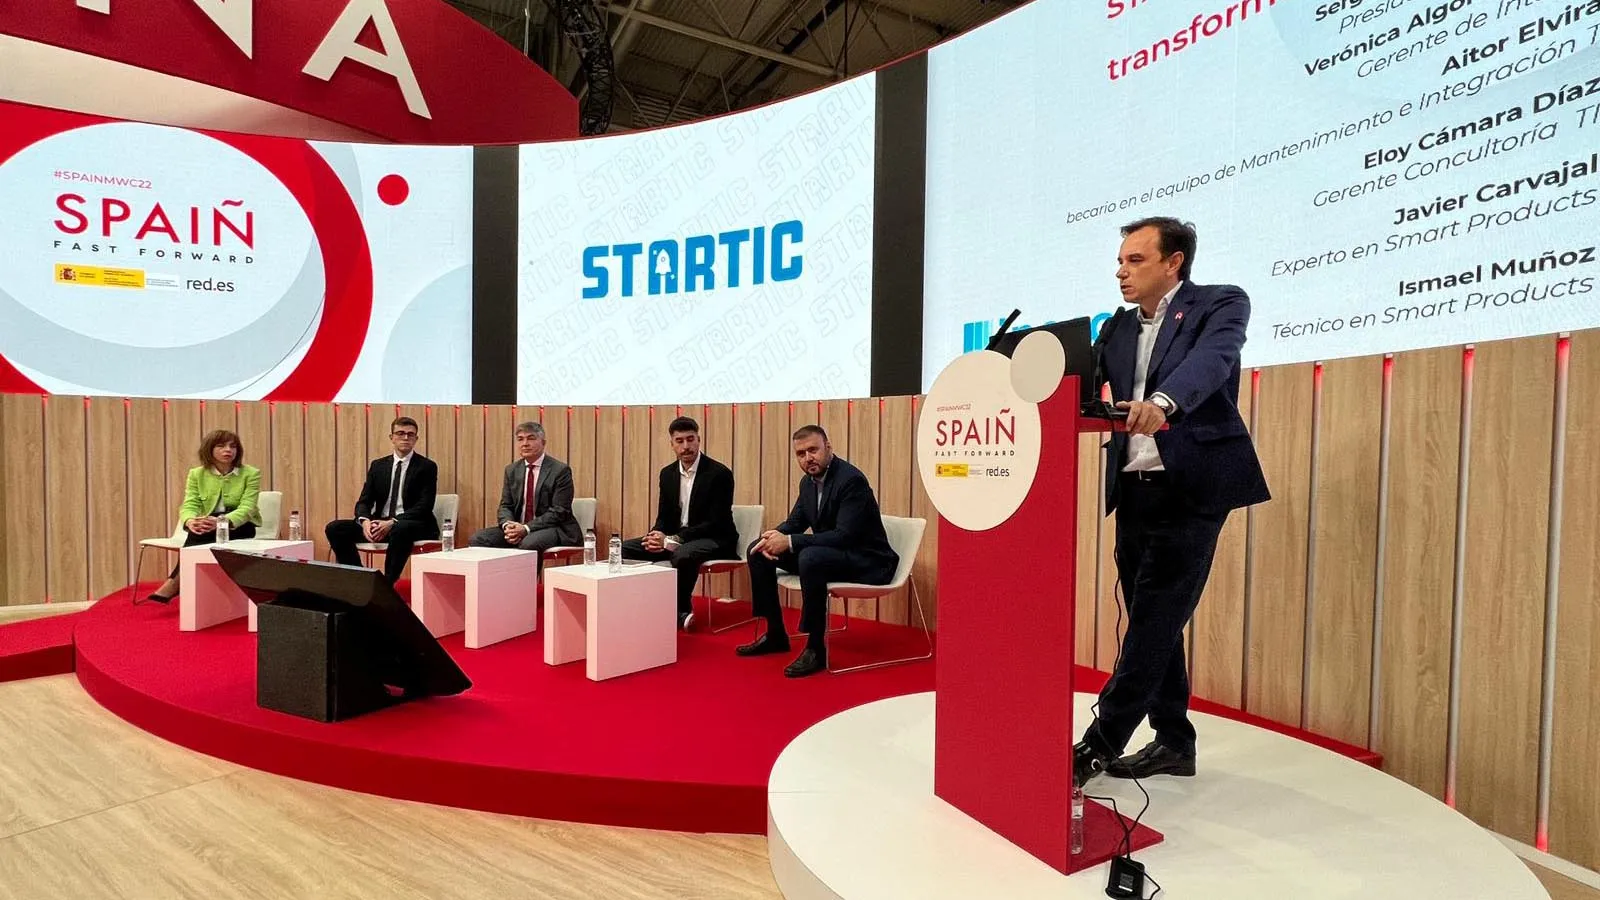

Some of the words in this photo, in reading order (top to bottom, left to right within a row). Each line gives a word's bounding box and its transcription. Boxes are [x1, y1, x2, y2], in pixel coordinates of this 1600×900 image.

[1304, 27, 1400, 76] Verónica
[1357, 30, 1448, 78] Gerente
[1455, 12, 1488, 36] de
[1441, 36, 1509, 75] Aitor
[1519, 0, 1600, 44] Elvira
[1066, 201, 1116, 224] becario
[1119, 197, 1137, 211] en
[1140, 188, 1153, 203] el
[1156, 172, 1210, 198] equipo
[1214, 164, 1236, 181] de
[1240, 109, 1392, 173] Mantenimiento
[1399, 101, 1412, 117] e
[1419, 37, 1575, 111] Integración
[1364, 142, 1412, 170] Eloy
[1418, 105, 1522, 151] Cámara
[1533, 76, 1600, 114] Díaz
[54, 170, 152, 189] #SPAINMWC22
[1313, 172, 1397, 207] Gerente
[1404, 121, 1558, 181] Concultoría
[1393, 191, 1468, 225] Javier
[1476, 153, 1597, 203] Carvajal
[54, 193, 254, 250] SPAIÑ
[54, 240, 117, 254] FAST
[139, 248, 254, 264] FORWARD
[1271, 251, 1346, 276] Experto
[1352, 242, 1378, 259] en
[1385, 220, 1459, 252] Smart
[1467, 188, 1597, 233] Products
[186, 278, 235, 292] red.es
[582, 220, 803, 299] STARTIC
[1399, 265, 1482, 296] Ismael
[1491, 246, 1596, 280] Muñoz
[1272, 316, 1344, 339] Técnico
[1350, 313, 1376, 328] en
[1381, 297, 1457, 324] Smart
[1465, 276, 1595, 311] Products
[936, 408, 1015, 446] SPAIÑ
[985, 466, 1010, 477] red.es
